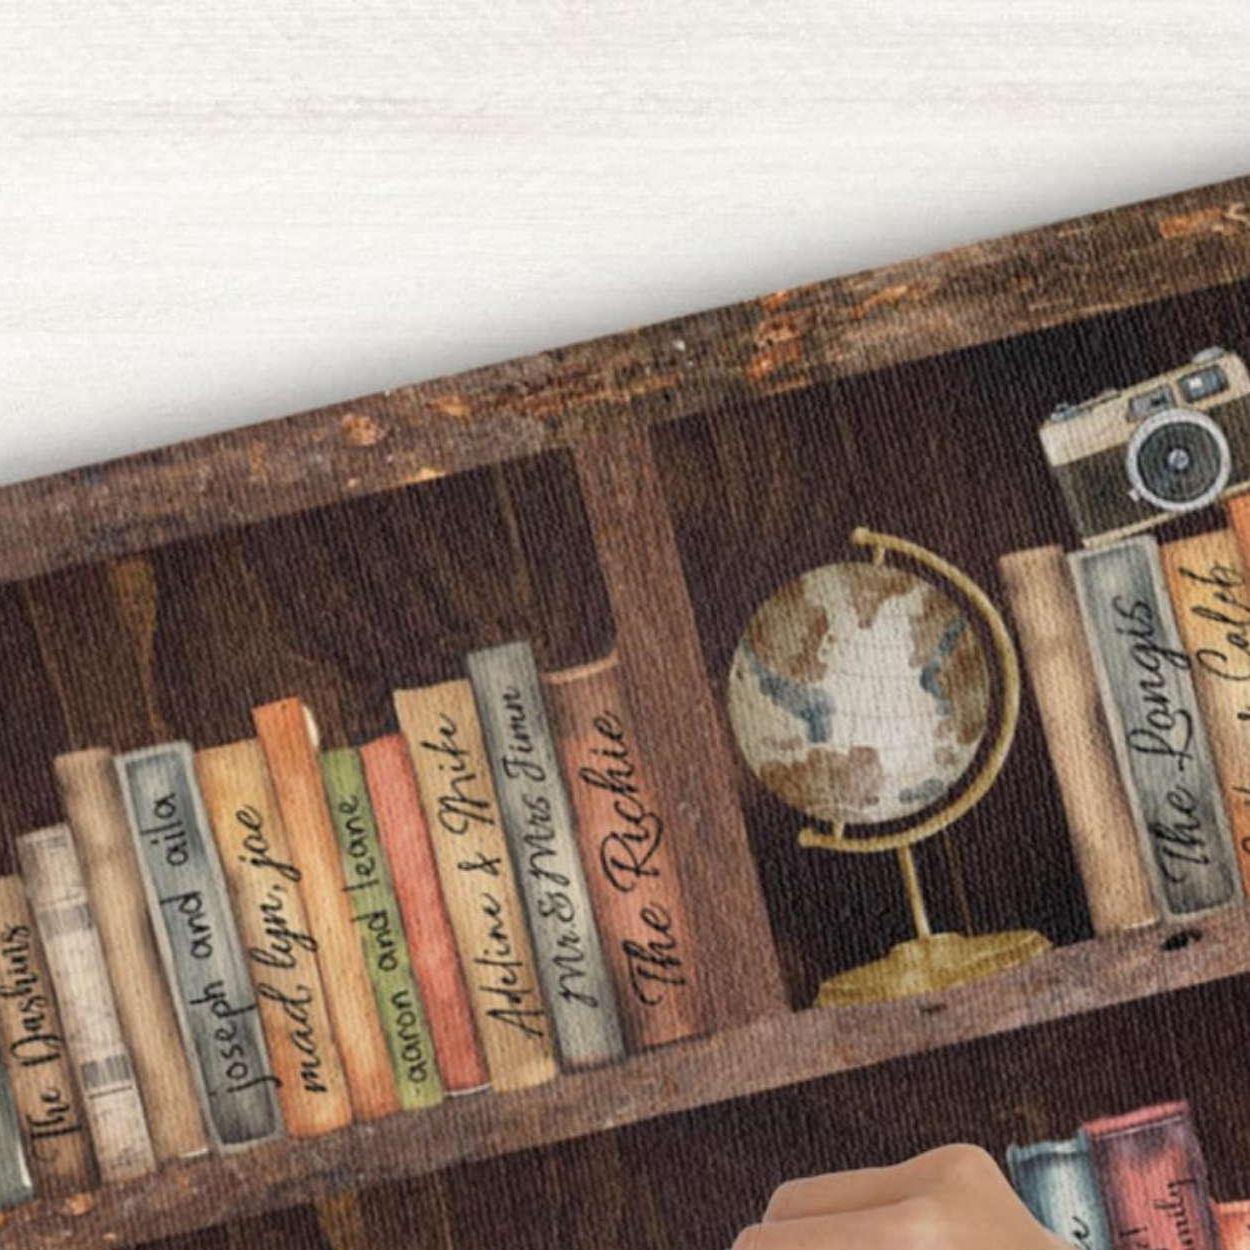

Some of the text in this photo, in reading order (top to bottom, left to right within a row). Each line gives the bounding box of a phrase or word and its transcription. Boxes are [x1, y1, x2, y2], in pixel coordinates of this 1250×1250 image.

[140, 791, 284, 1094] joseph and aila
[237, 804, 302, 885] joe
[338, 793, 427, 1084] aaron and leane
[422, 713, 546, 1038] Adeline & Mike
[581, 711, 688, 1008] The Richie
[1149, 786, 1211, 886] The
[30, 1085, 82, 1164] The
